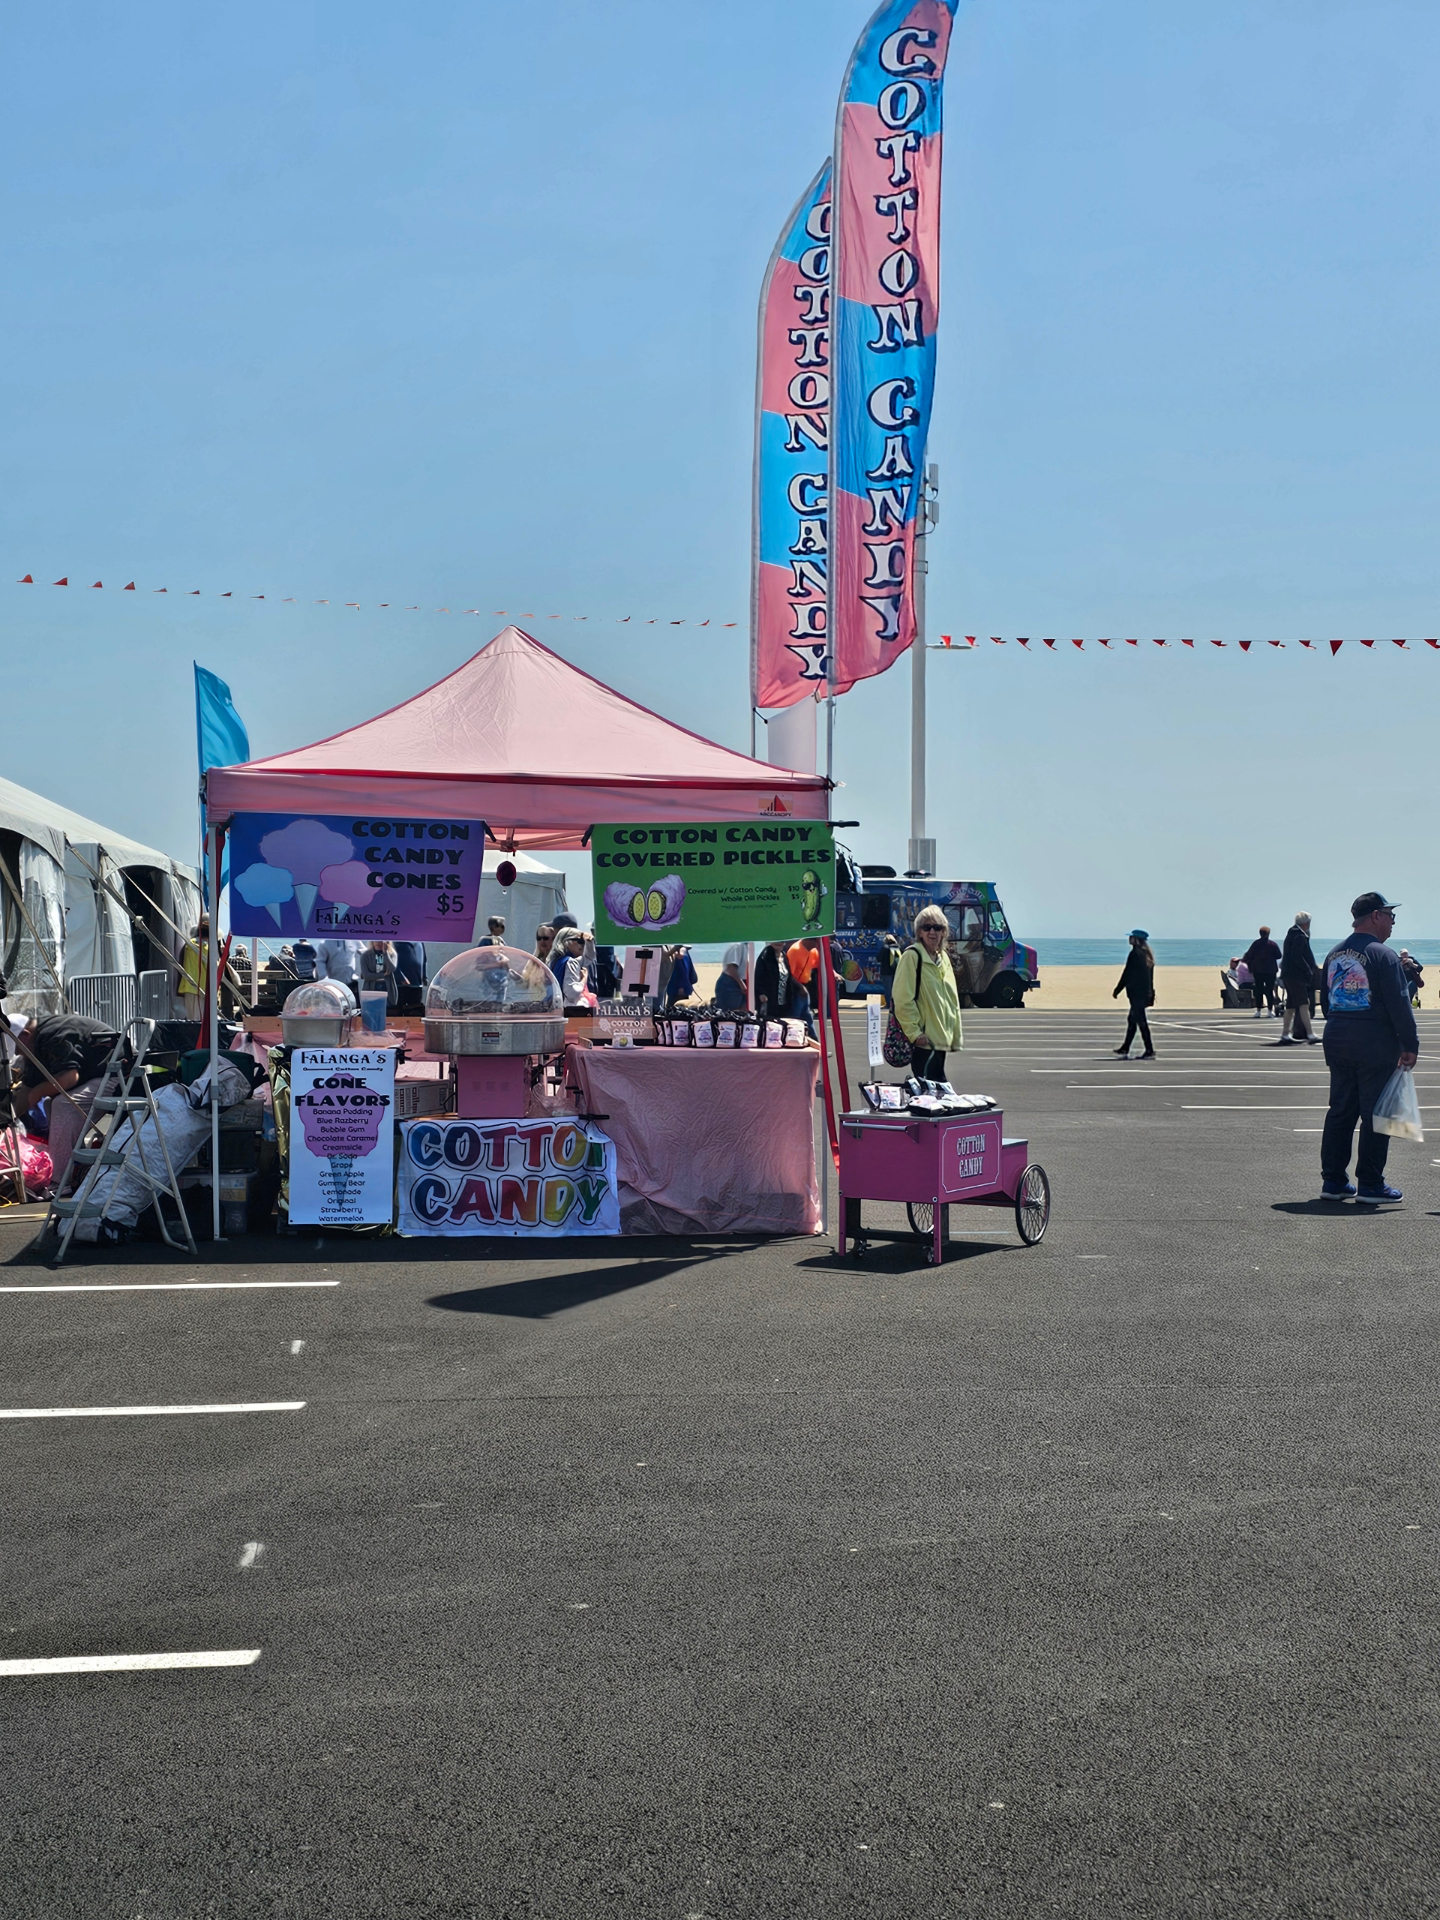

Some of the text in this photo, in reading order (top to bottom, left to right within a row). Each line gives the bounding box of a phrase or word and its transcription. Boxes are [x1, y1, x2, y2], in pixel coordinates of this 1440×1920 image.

[859, 26, 938, 642] COTTON CANDY
[352, 820, 469, 840] COTTON
[613, 826, 813, 845] COTTON CANDY
[364, 846, 463, 865] CANDY
[596, 849, 831, 868] COVERED PICKLES
[366, 871, 461, 890] CONES
[688, 887, 717, 895] Covered
[729, 886, 753, 894] Cotton
[754, 885, 777, 894] Candy
[436, 892, 464, 916] $5
[756, 893, 780, 901] Pickles
[312, 1077, 367, 1089] CONE
[295, 1095, 390, 1107] FLAVORS
[335, 1117, 369, 1125] Razberry
[343, 1108, 373, 1116] Pudding
[956, 1134, 986, 1156] COTTON
[331, 1162, 353, 1170] Grape
[958, 1157, 984, 1178] CANDY
[327, 1198, 356, 1206] Original
[411, 1174, 608, 1226] CANDY
